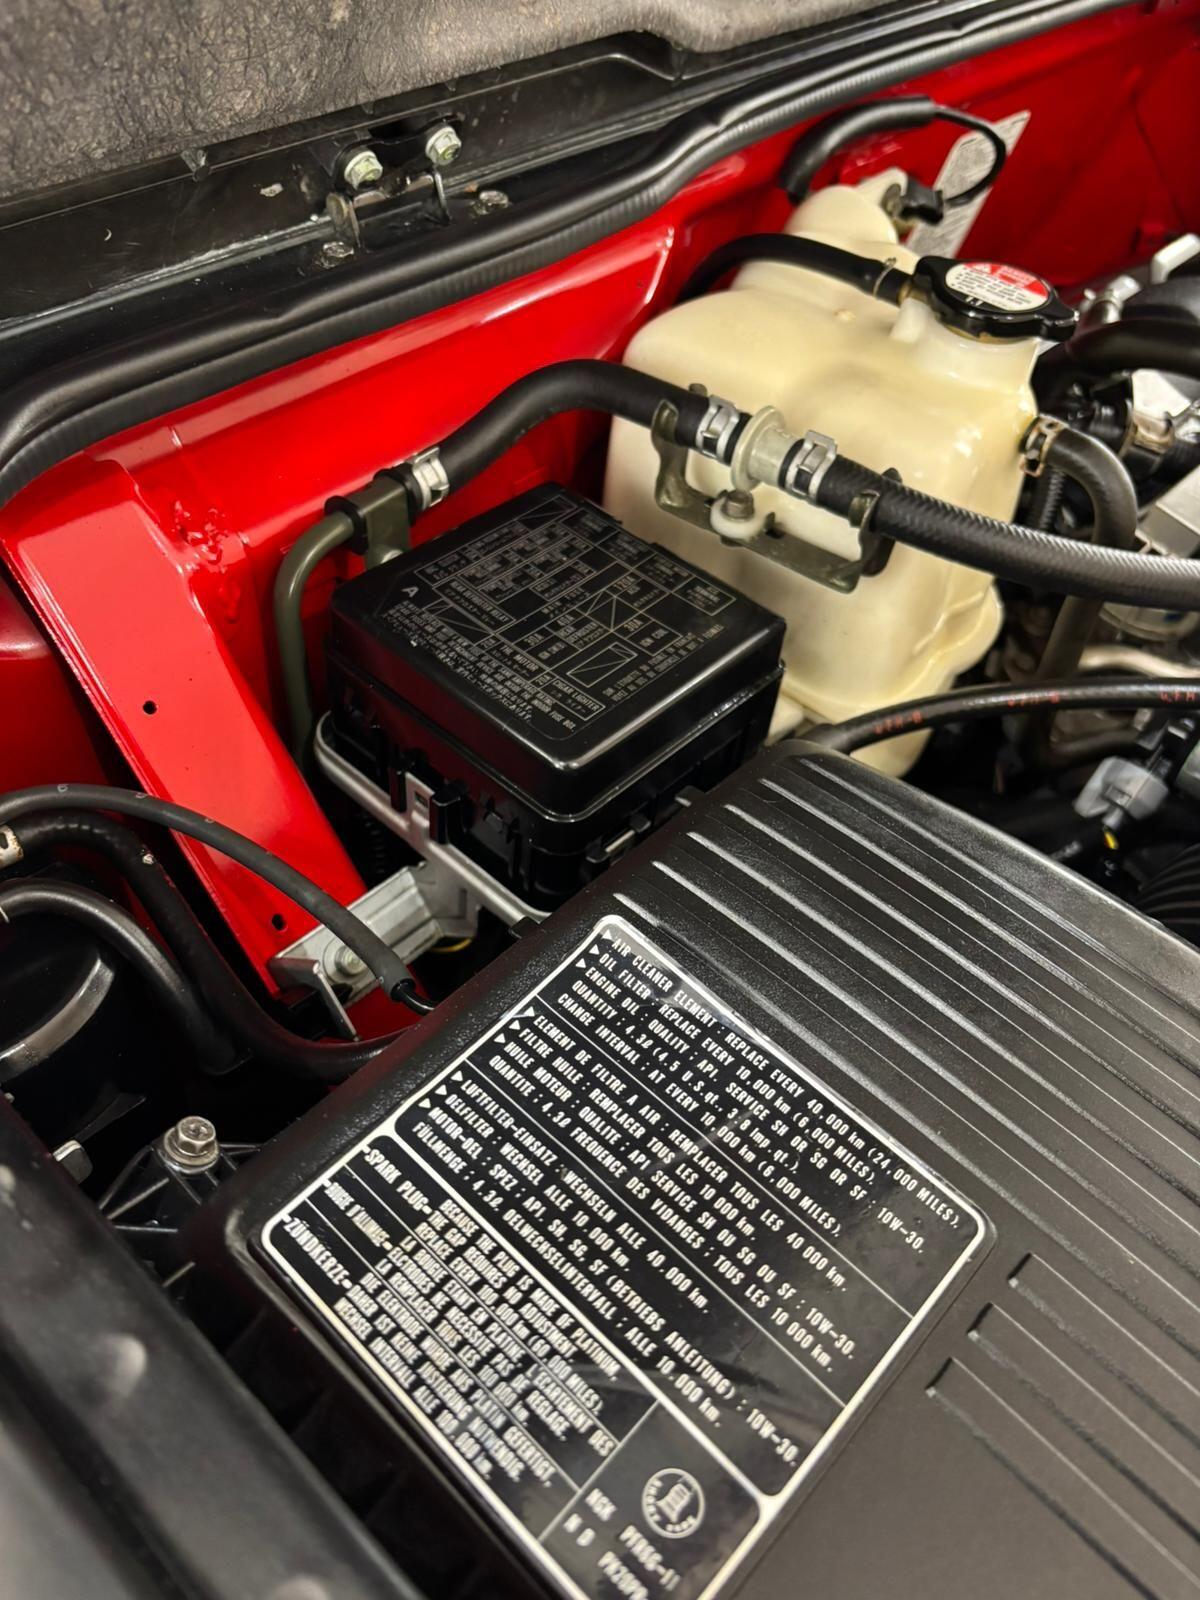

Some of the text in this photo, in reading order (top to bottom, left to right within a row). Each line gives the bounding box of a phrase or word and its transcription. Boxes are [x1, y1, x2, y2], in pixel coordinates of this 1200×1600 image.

[402, 586, 418, 598] A
[552, 678, 600, 711] CIGAR LIGHTER
[518, 1027, 554, 1059] FILTRE
[551, 1055, 584, 1085] HUILE
[588, 1087, 647, 1140] REMPLACER
[646, 1136, 676, 1165] TOUS
[674, 1162, 699, 1186] LES
[699, 1183, 717, 1201] 10
[712, 1196, 740, 1221] 000
[532, 1014, 577, 1052] ELEMENT
[574, 1049, 593, 1066] DE
[590, 1062, 628, 1096] FILTRE
[625, 1094, 639, 1106] A
[637, 1104, 662, 1126] AIR
[667, 1128, 729, 1184] REMPLACER
[729, 1180, 761, 1211] TOUS
[759, 1208, 785, 1232] LES
[786, 1232, 805, 1250] 40
[802, 1245, 829, 1271] 000
[557, 992, 841, 1238] CHANGE INTERVAL AT EVERY 10,000 km (6,000 MILES).
[571, 979, 619, 1020] QUANTITY
[652, 1046, 681, 1072] (4.5
[584, 966, 924, 1254] ENGINE OIL QUALITY API. SERVICE SH OR SG OR SF 10W-30.
[598, 952, 875, 1186] OIL FILTER REPLACE EVERY 10,000 km (6,000 MILES).
[611, 937, 960, 1229] AIR CLEANER ELEMENT REPLACE EVERY 40,000 km (24,000 MILES).
[283, 1217, 350, 1286] ZÜNDKERZE
[363, 1148, 429, 1211] SPARK PLUG
[411, 1121, 468, 1175] FÜLLMENGE
[502, 1208, 618, 1321] OELWECHSELINTERVALL
[623, 1326, 658, 1358] ALLE
[698, 1397, 721, 1427] km.
[427, 1106, 484, 1160] MOTOR-OEL
[488, 1163, 519, 1192] SPEZ
[547, 1218, 568, 1242] SH,
[567, 1238, 589, 1263] SG,
[588, 1258, 609, 1276] SF
[605, 1274, 667, 1332] (BETRIEBS
[663, 1330, 736, 1400] ANLEITUNG)
[427, 1209, 579, 1363] THE GAP REQUIRES NO ADJUSTMENT.
[438, 1198, 480, 1238] BECAUSE
[474, 1232, 498, 1255] THE
[491, 1250, 521, 1278] PLUG
[515, 1274, 535, 1292] IS
[528, 1287, 561, 1317] MADE
[555, 1312, 576, 1330] OF
[444, 1093, 495, 1139] OELFILTER
[499, 1141, 545, 1187] WECHSEL
[543, 1184, 574, 1212] ALLE
[609, 1246, 630, 1272] km.
[460, 1079, 559, 1167] LUFTFILTER-EINSATZ
[561, 1170, 618, 1223] WECHSELN
[615, 1221, 647, 1250] ALLE
[687, 1287, 709, 1314] km.
[488, 1054, 536, 1097] QUANTITE
[569, 1126, 628, 1179] FREQUENCE
[625, 1175, 651, 1200] DES
[649, 1197, 706, 1249] VIDANGES
[712, 1254, 746, 1286] TOUS
[744, 1283, 771, 1309] LES
[770, 1307, 790, 1326] 10
[786, 1321, 814, 1349] 000
[503, 1041, 855, 1360] HUILE MOTEUR QUALITE API SERVICE SH OU SG OU SF 10W-30.
